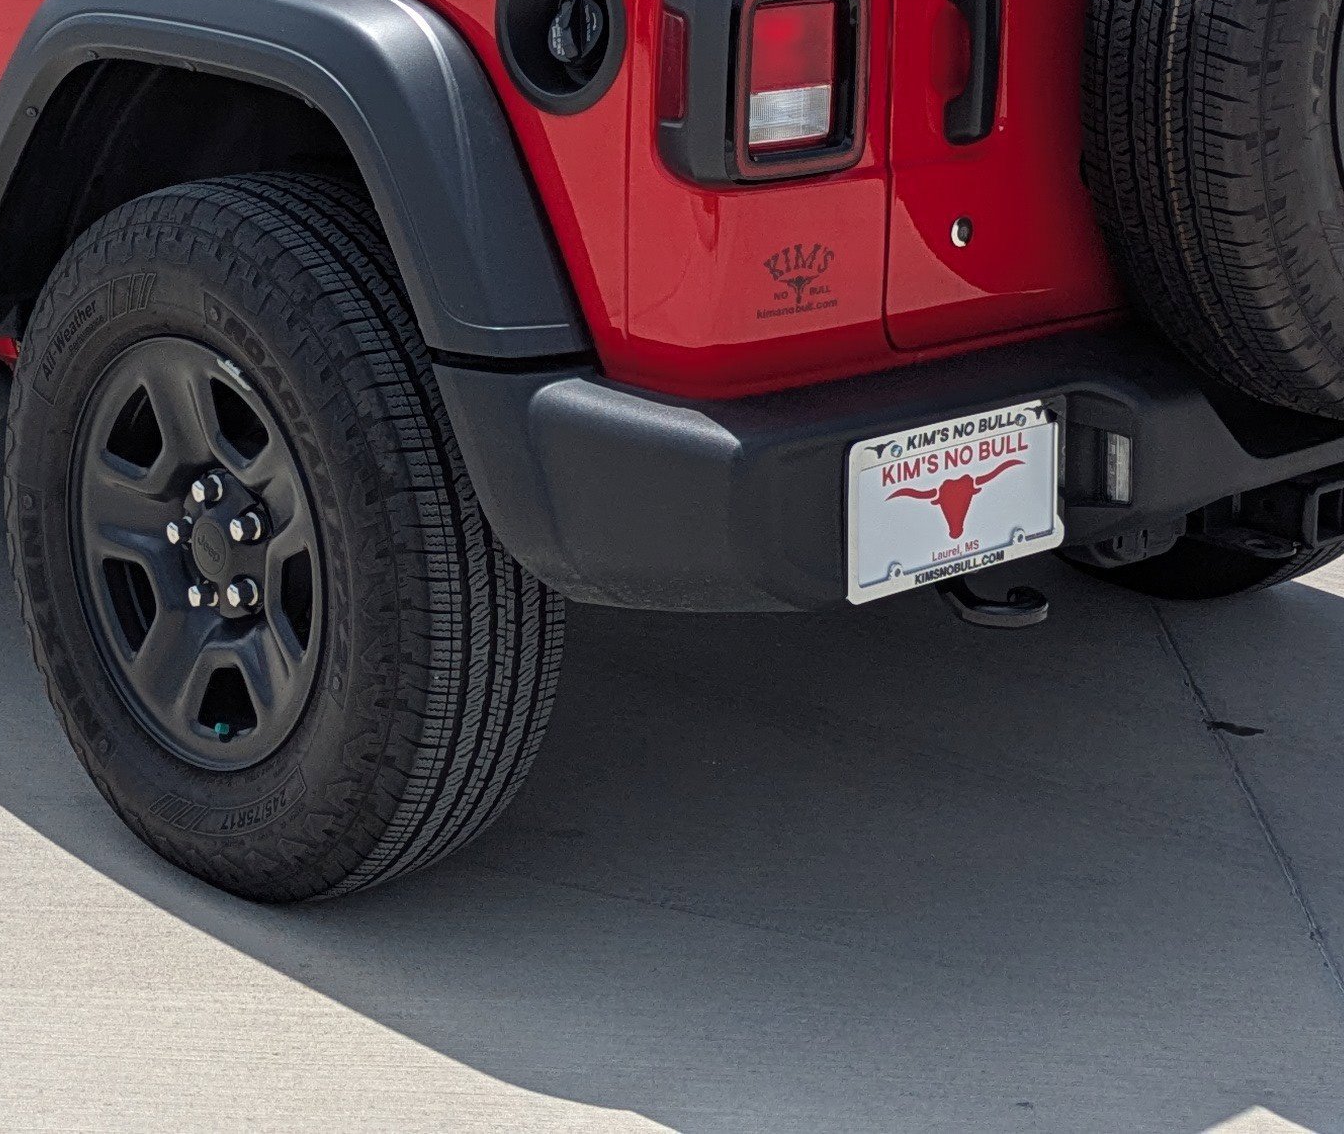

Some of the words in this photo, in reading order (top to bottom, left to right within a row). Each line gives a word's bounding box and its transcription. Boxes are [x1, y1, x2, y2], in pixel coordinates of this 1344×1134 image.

[773, 291, 789, 300] NO
[38, 293, 100, 385] All-Weather
[906, 427, 950, 452] KIM'S
[953, 422, 974, 440] NO
[978, 412, 1017, 434] BULL
[881, 453, 939, 487] KIM'S
[944, 445, 973, 471] NO
[978, 432, 1029, 461] BULL
[197, 534, 221, 563] Jeep
[914, 549, 1005, 585] KIMSNOBULL.COM
[932, 543, 962, 562] Laurel,
[964, 539, 980, 553] MS
[217, 786, 290, 830] 245/75R17
